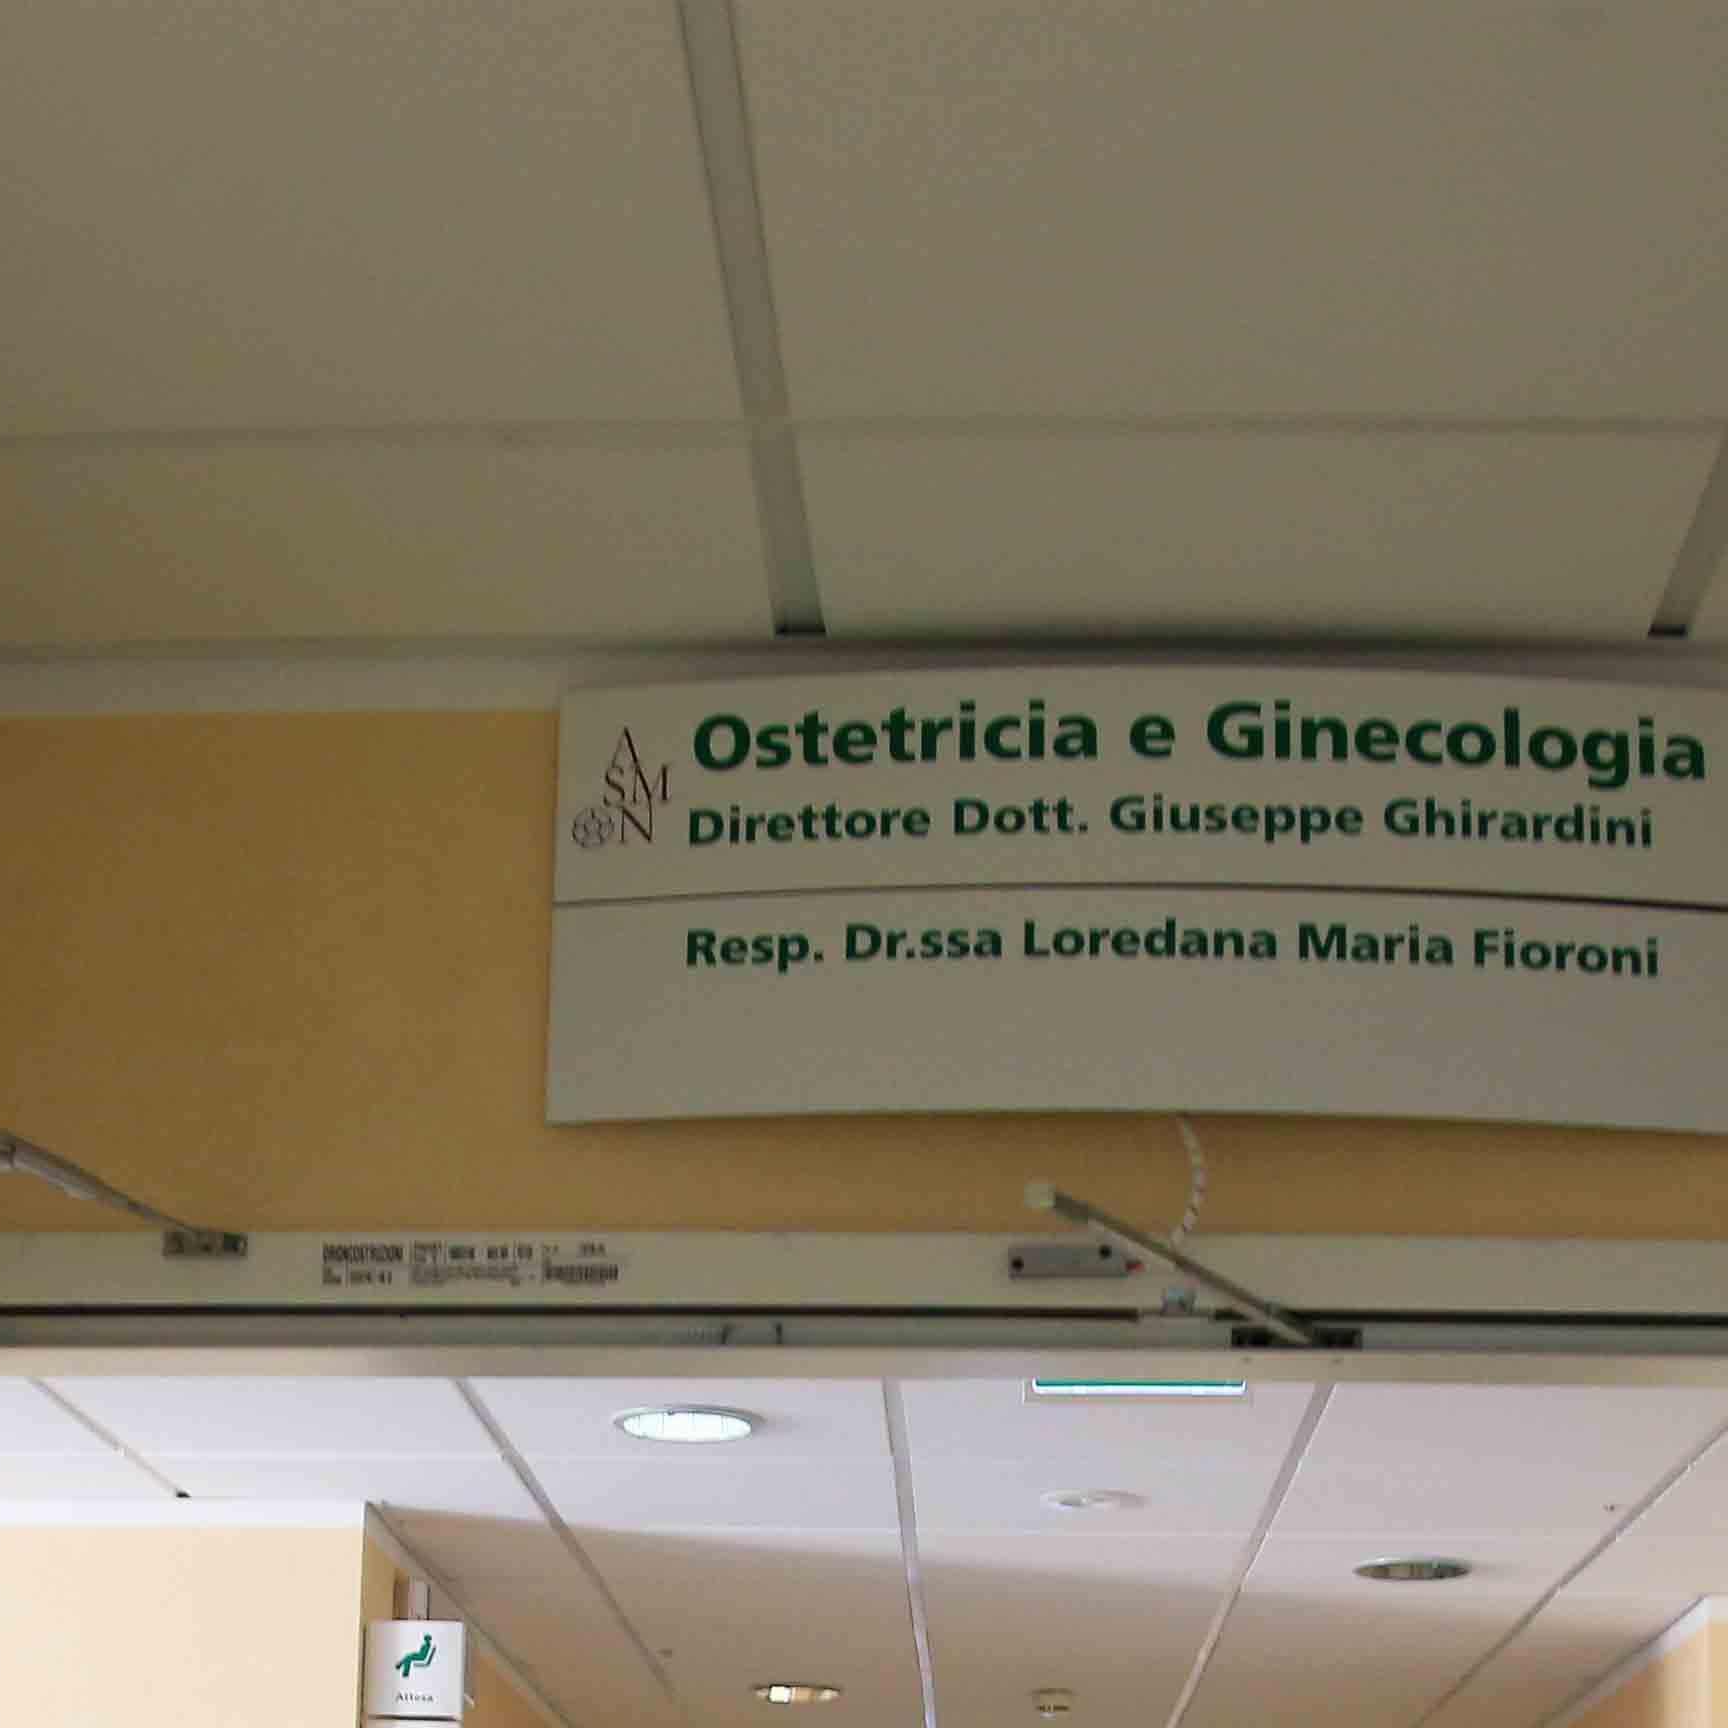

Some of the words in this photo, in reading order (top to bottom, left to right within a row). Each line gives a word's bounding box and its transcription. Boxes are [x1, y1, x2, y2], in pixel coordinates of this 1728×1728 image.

[693, 699, 1098, 773] Ostetricia
[1129, 714, 1176, 760] e
[1206, 699, 1706, 791] Ginecologia
[687, 803, 931, 848] Direttore
[952, 796, 1089, 837] Dott.
[1109, 793, 1364, 845] Giuseppe
[1383, 796, 1653, 849] Ghirardini
[686, 929, 824, 975] Resp.
[845, 923, 1003, 962] Dr.ssa
[1022, 917, 1277, 962] Loredana
[1298, 922, 1454, 967] Maria
[1472, 927, 1659, 978] Fioroni
